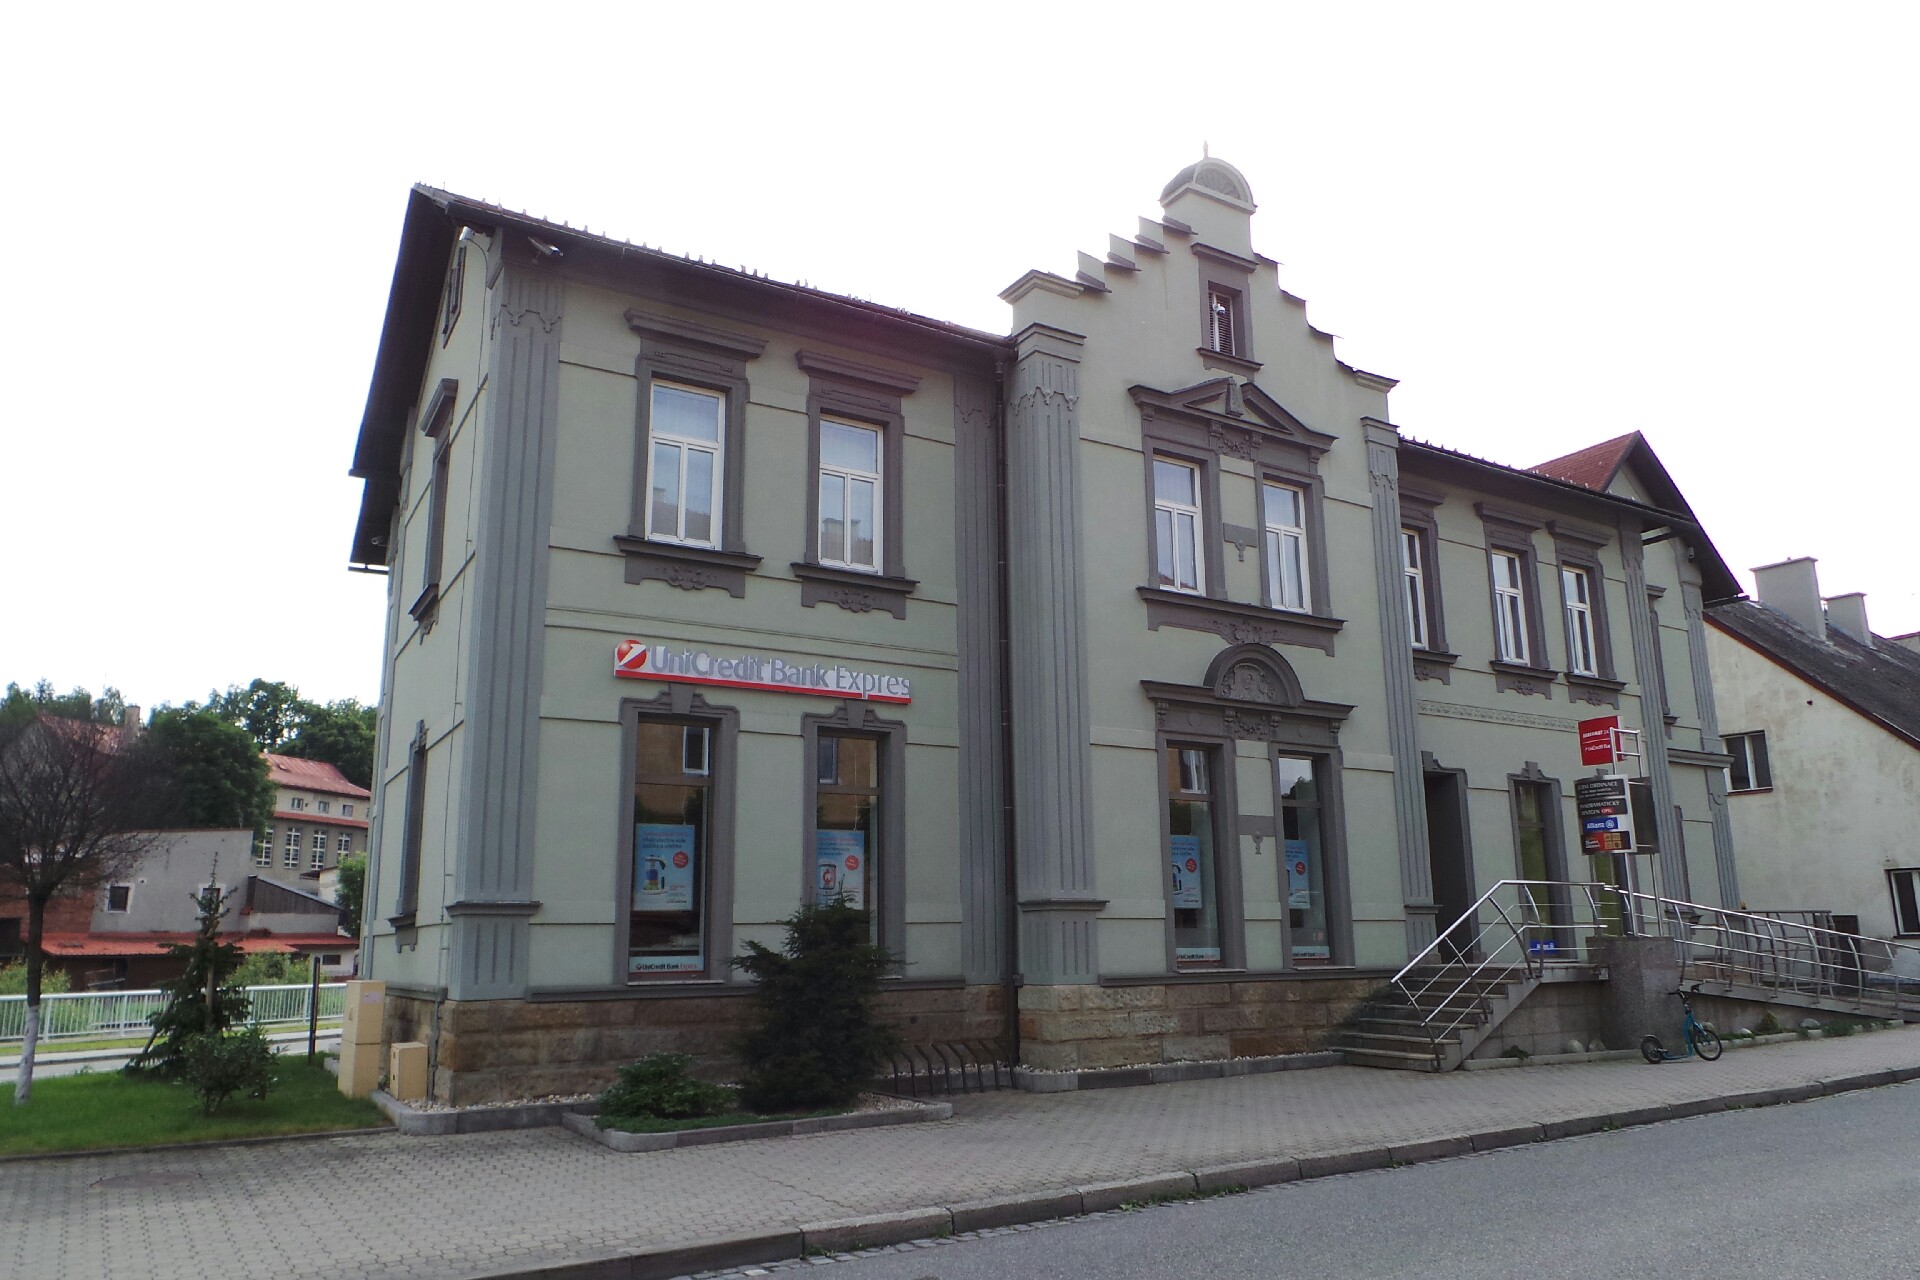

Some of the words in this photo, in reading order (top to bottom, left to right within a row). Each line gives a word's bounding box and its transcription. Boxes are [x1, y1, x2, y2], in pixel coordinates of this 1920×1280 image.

[650, 645, 764, 683] UniCredit
[770, 657, 829, 689] Bank
[836, 664, 910, 699] Expres
[642, 963, 665, 971] UniCredit
